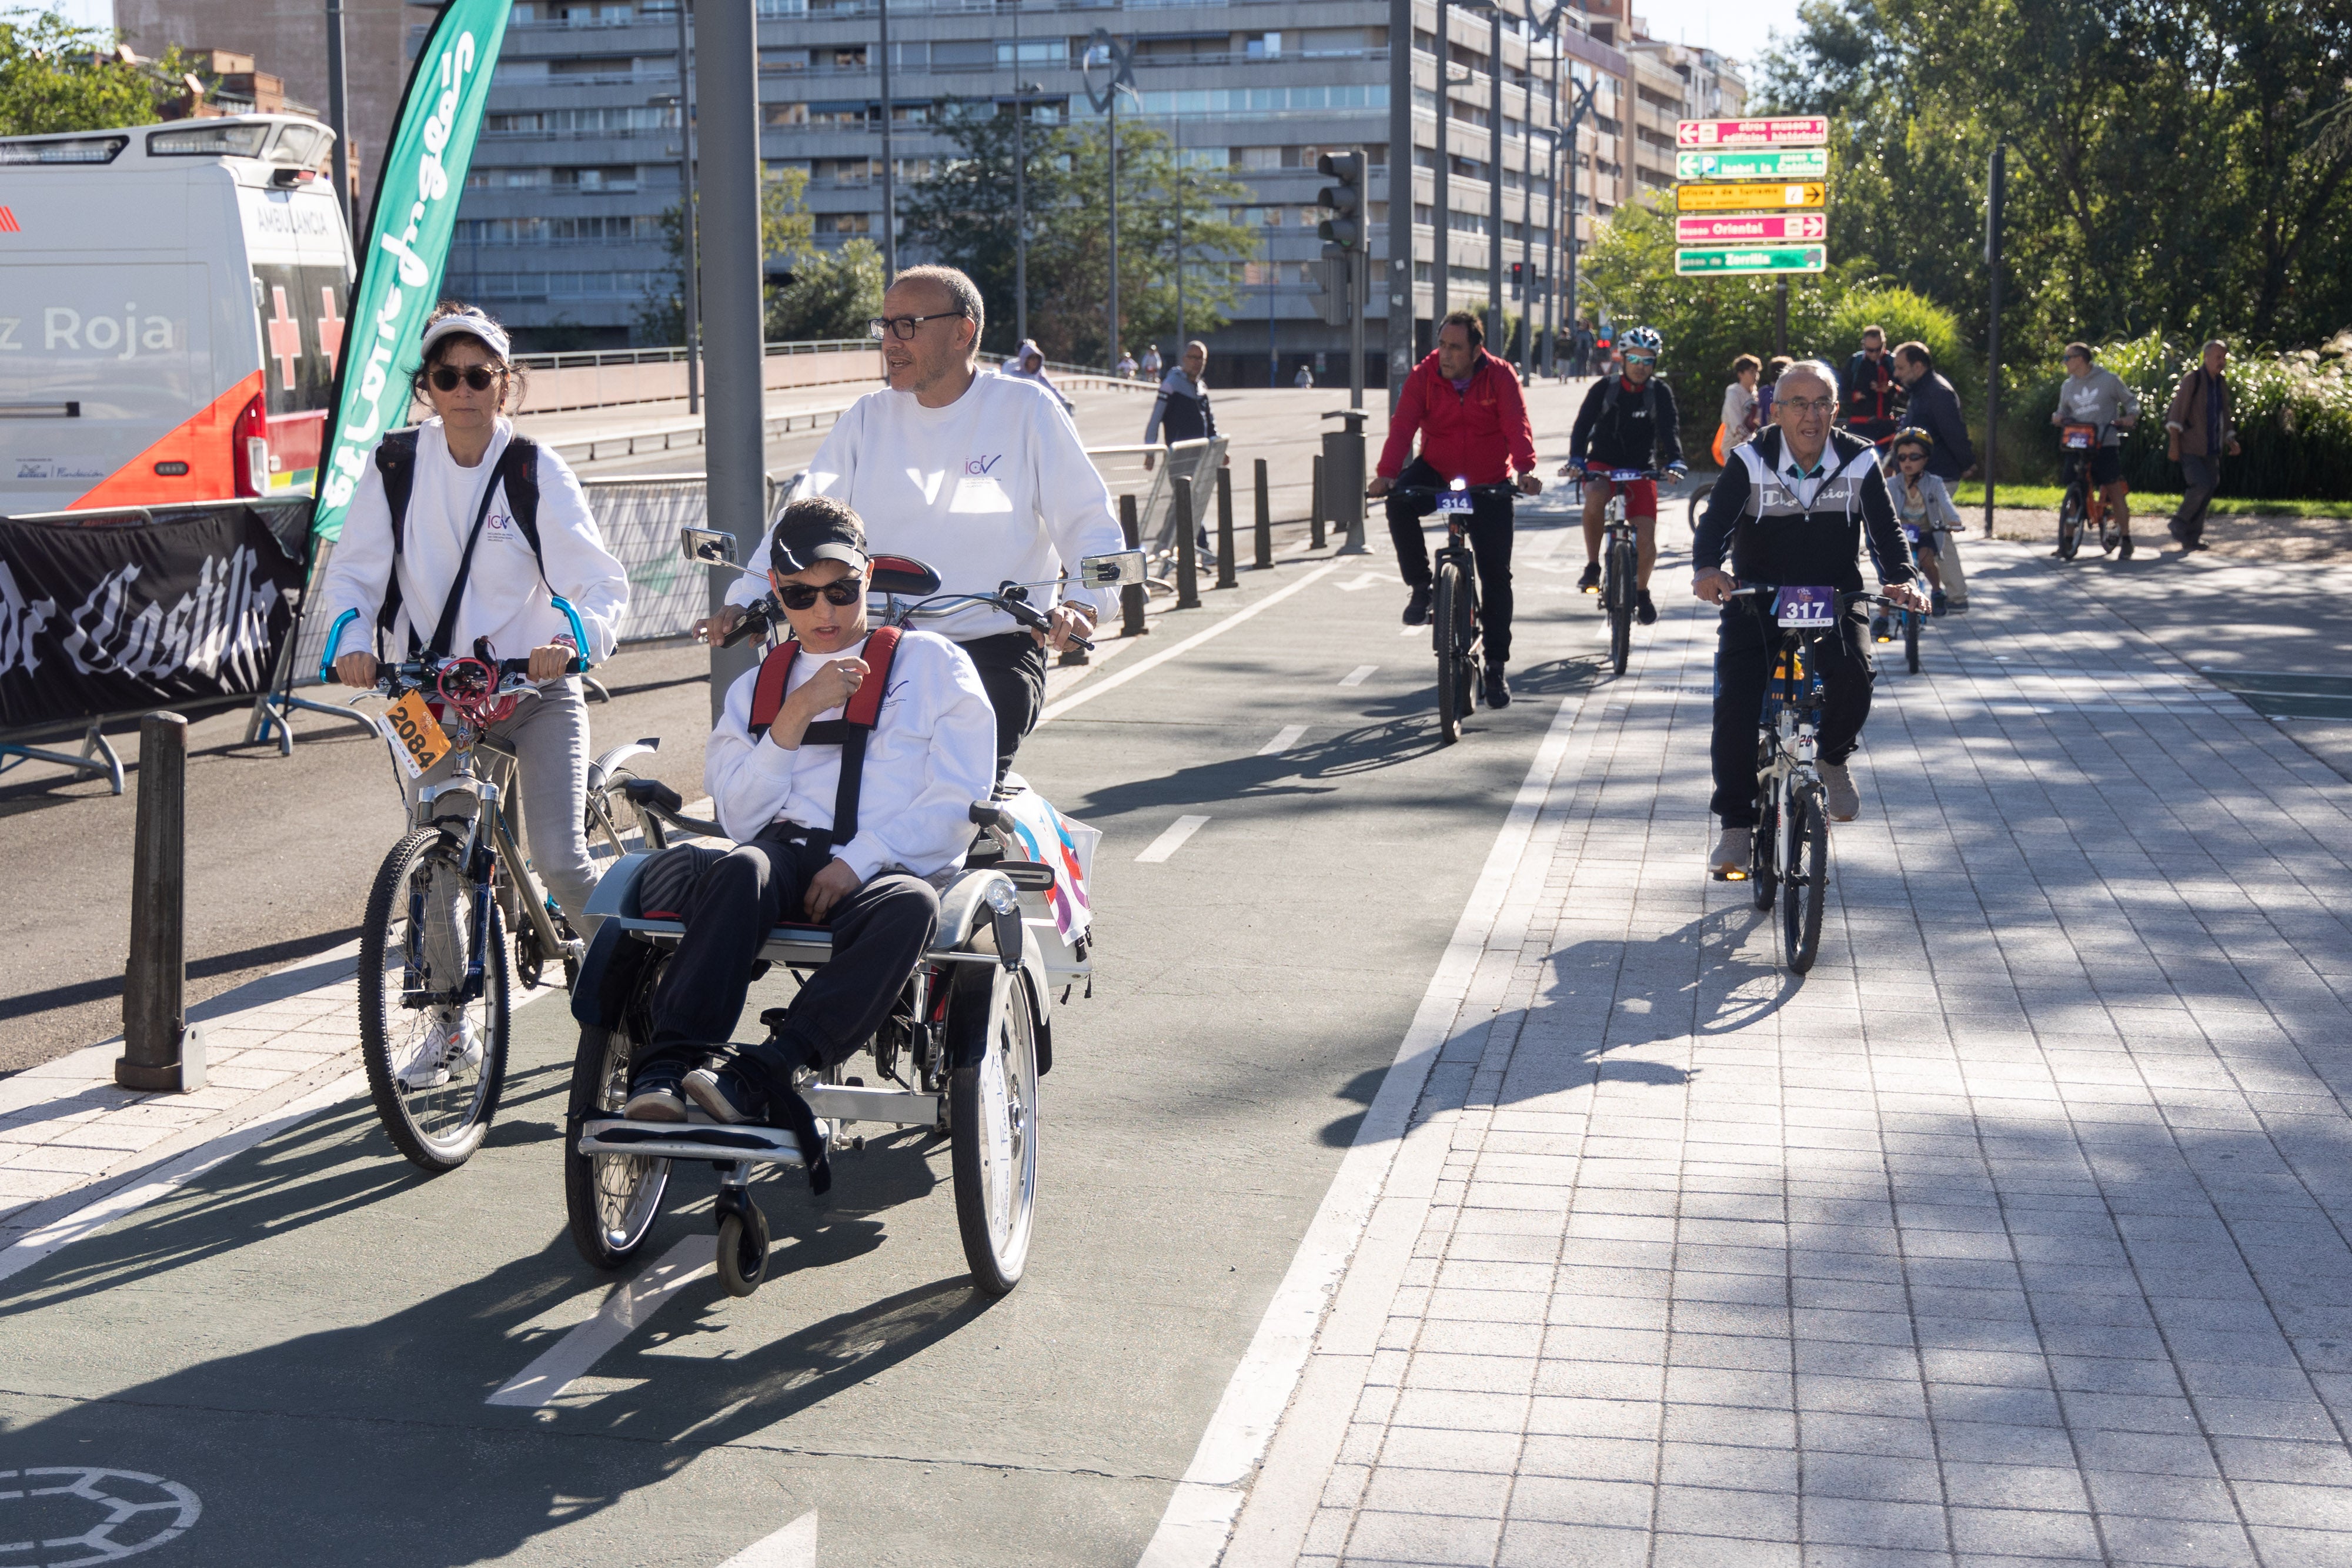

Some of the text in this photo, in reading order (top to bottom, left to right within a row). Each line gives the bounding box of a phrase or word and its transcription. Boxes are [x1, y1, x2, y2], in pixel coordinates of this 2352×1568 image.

[1738, 121, 1823, 132] otros museos y
[1722, 131, 1823, 142] edificios históricos
[382, 31, 475, 288] Inglés
[1721, 163, 1756, 173] Isabel
[1760, 162, 1772, 173] la
[257, 205, 329, 235] AMBULANCIA
[1712, 222, 1763, 235] Oriental
[1725, 252, 1770, 266] Zorrilla
[44, 301, 173, 360] Roja
[1442, 498, 1468, 508] 314
[1786, 602, 1825, 618] 317
[388, 707, 436, 768] 2084
[1799, 734, 1812, 747] 20
